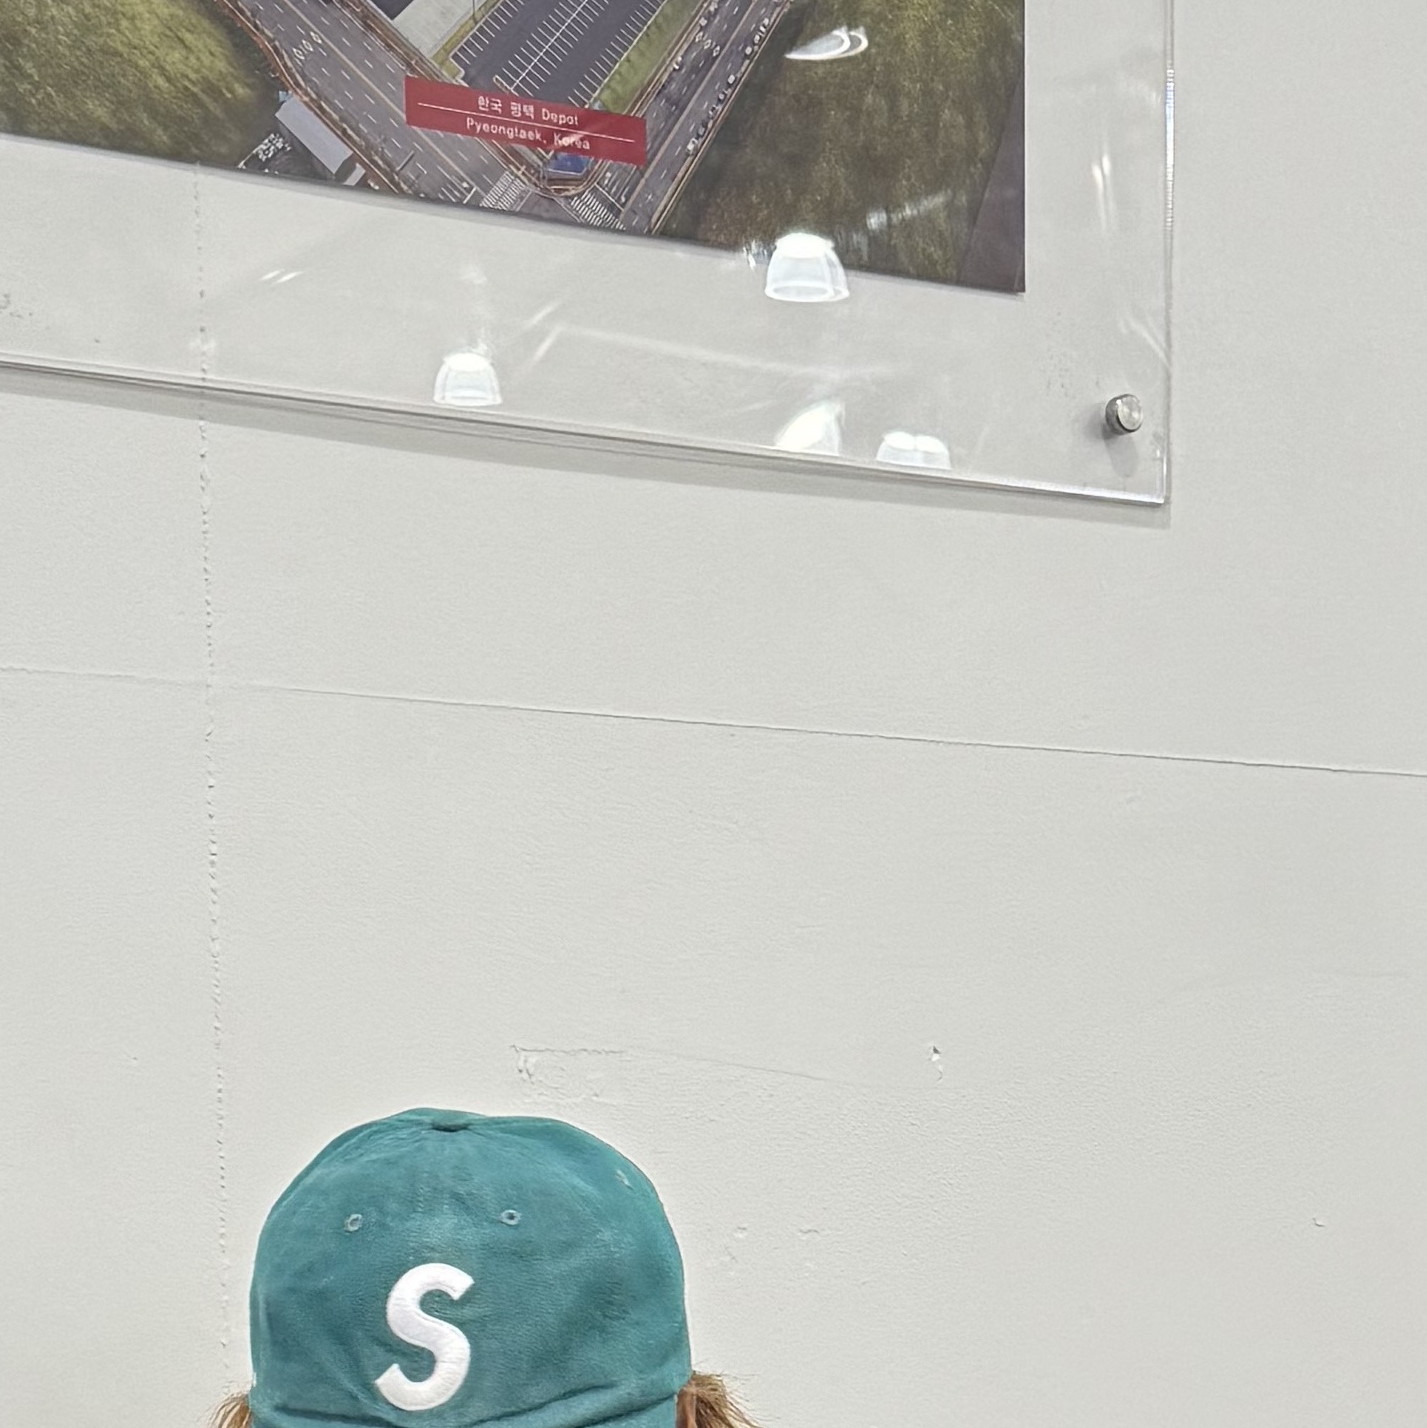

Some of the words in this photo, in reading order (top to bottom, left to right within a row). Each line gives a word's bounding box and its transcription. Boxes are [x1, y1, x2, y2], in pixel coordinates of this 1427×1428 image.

[478, 95, 502, 113] 한국
[510, 101, 534, 119] 평택
[542, 107, 579, 126] Depot
[553, 132, 590, 150] Korea
[375, 1261, 475, 1412] S
